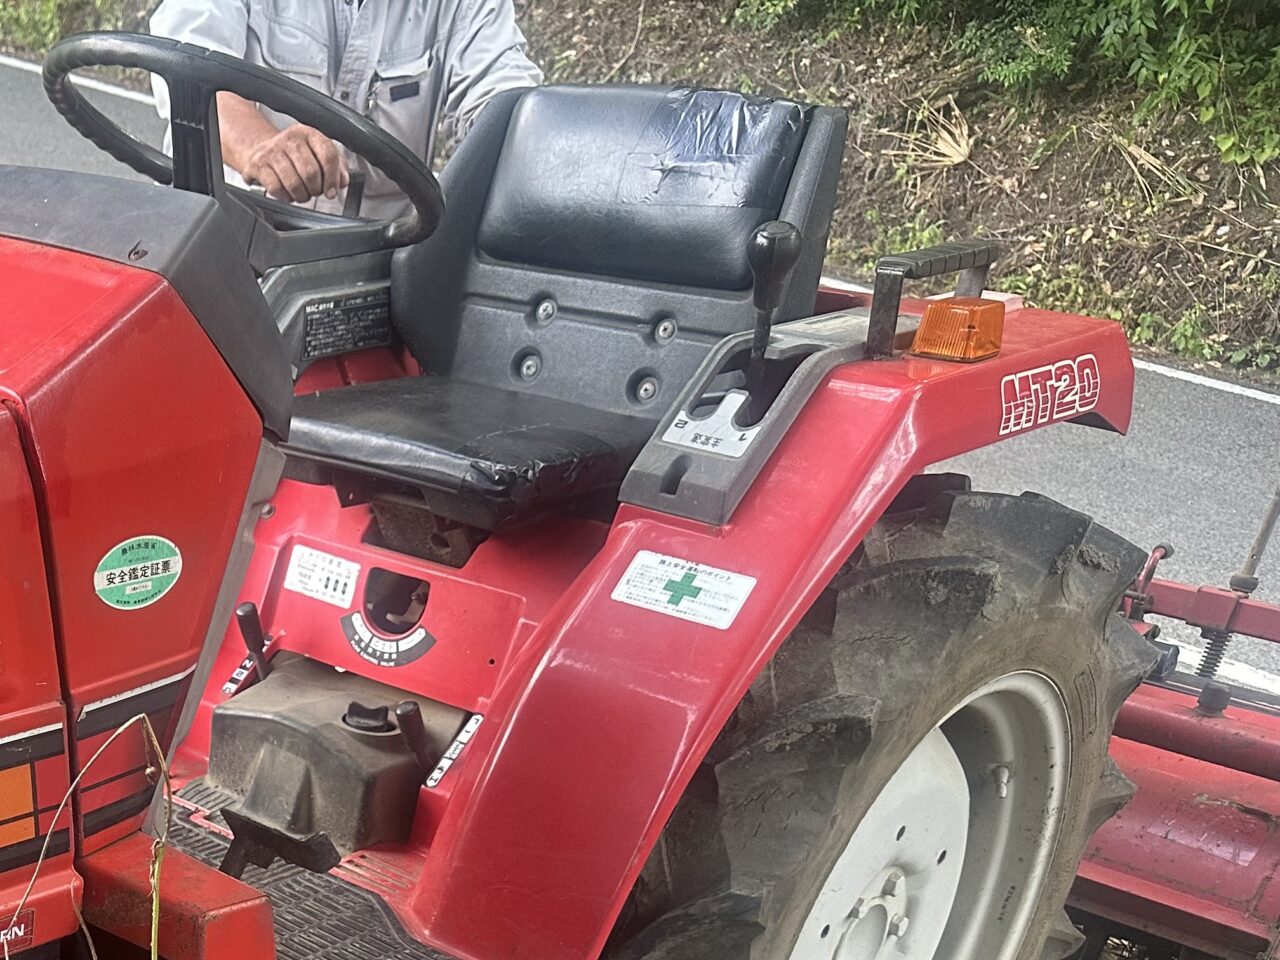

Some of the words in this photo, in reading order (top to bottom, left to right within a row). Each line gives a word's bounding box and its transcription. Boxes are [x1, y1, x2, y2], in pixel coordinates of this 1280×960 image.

[998, 353, 1101, 436] MT20
[105, 559, 172, 586] 安全鑑定証票
